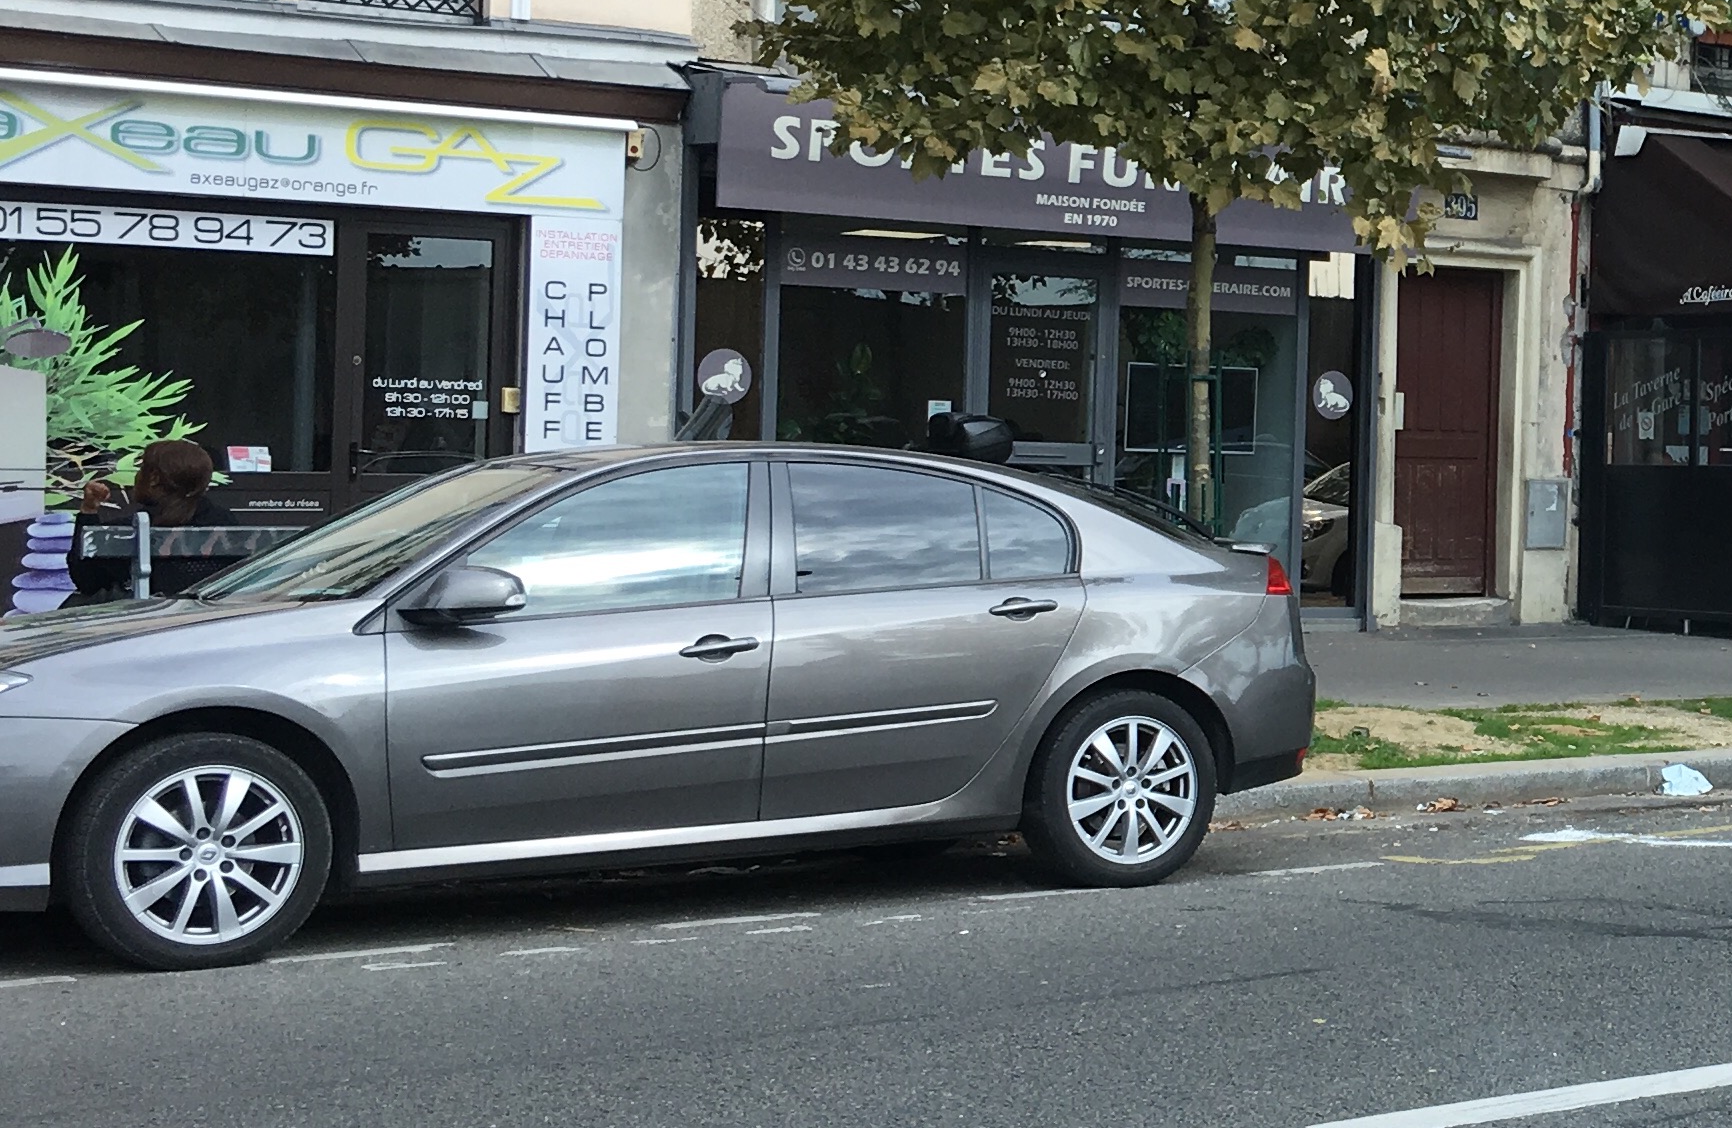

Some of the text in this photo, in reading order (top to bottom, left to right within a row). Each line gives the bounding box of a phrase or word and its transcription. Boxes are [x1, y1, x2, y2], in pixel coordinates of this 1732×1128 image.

[345, 120, 606, 212] GAZ
[190, 172, 378, 197] axeaugaz@orange.fr
[1035, 193, 1146, 213] MAISON FONDÉE
[1064, 212, 1117, 227] EN 1970
[0, 205, 326, 249] 1 55 78 94 73
[536, 229, 618, 242] INSTALLATION
[544, 240, 609, 252] ENTRETIEN
[811, 251, 836, 269] 01
[843, 254, 869, 271] 43
[874, 256, 900, 273] 43
[905, 258, 930, 274] 62
[935, 259, 961, 277] 94
[992, 305, 1091, 321] DU LUNDI AU JEUDI
[1009, 327, 1036, 338] 9H00
[1044, 329, 1076, 340] 12H30
[1006, 337, 1038, 348] 13H30
[1047, 339, 1079, 350] 18H00
[372, 377, 483, 390] du Lundi au Vendredi
[1008, 377, 1036, 388] 9H00
[1044, 380, 1076, 390] 12H30
[1613, 367, 1681, 410] La Taverne
[385, 392, 402, 402] 8h
[403, 393, 421, 403] 30
[430, 393, 450, 403] 12h
[451, 394, 470, 404] 00
[1006, 387, 1038, 398] 13H30
[1046, 390, 1079, 400] 17H00
[386, 406, 405, 417] 13h
[406, 407, 426, 417] 30
[434, 408, 454, 418] 17h
[455, 409, 469, 418] 15
[1619, 412, 1633, 431] de
[1651, 392, 1682, 415] Gare
[249, 499, 283, 507] membre
[284, 499, 295, 507] du
